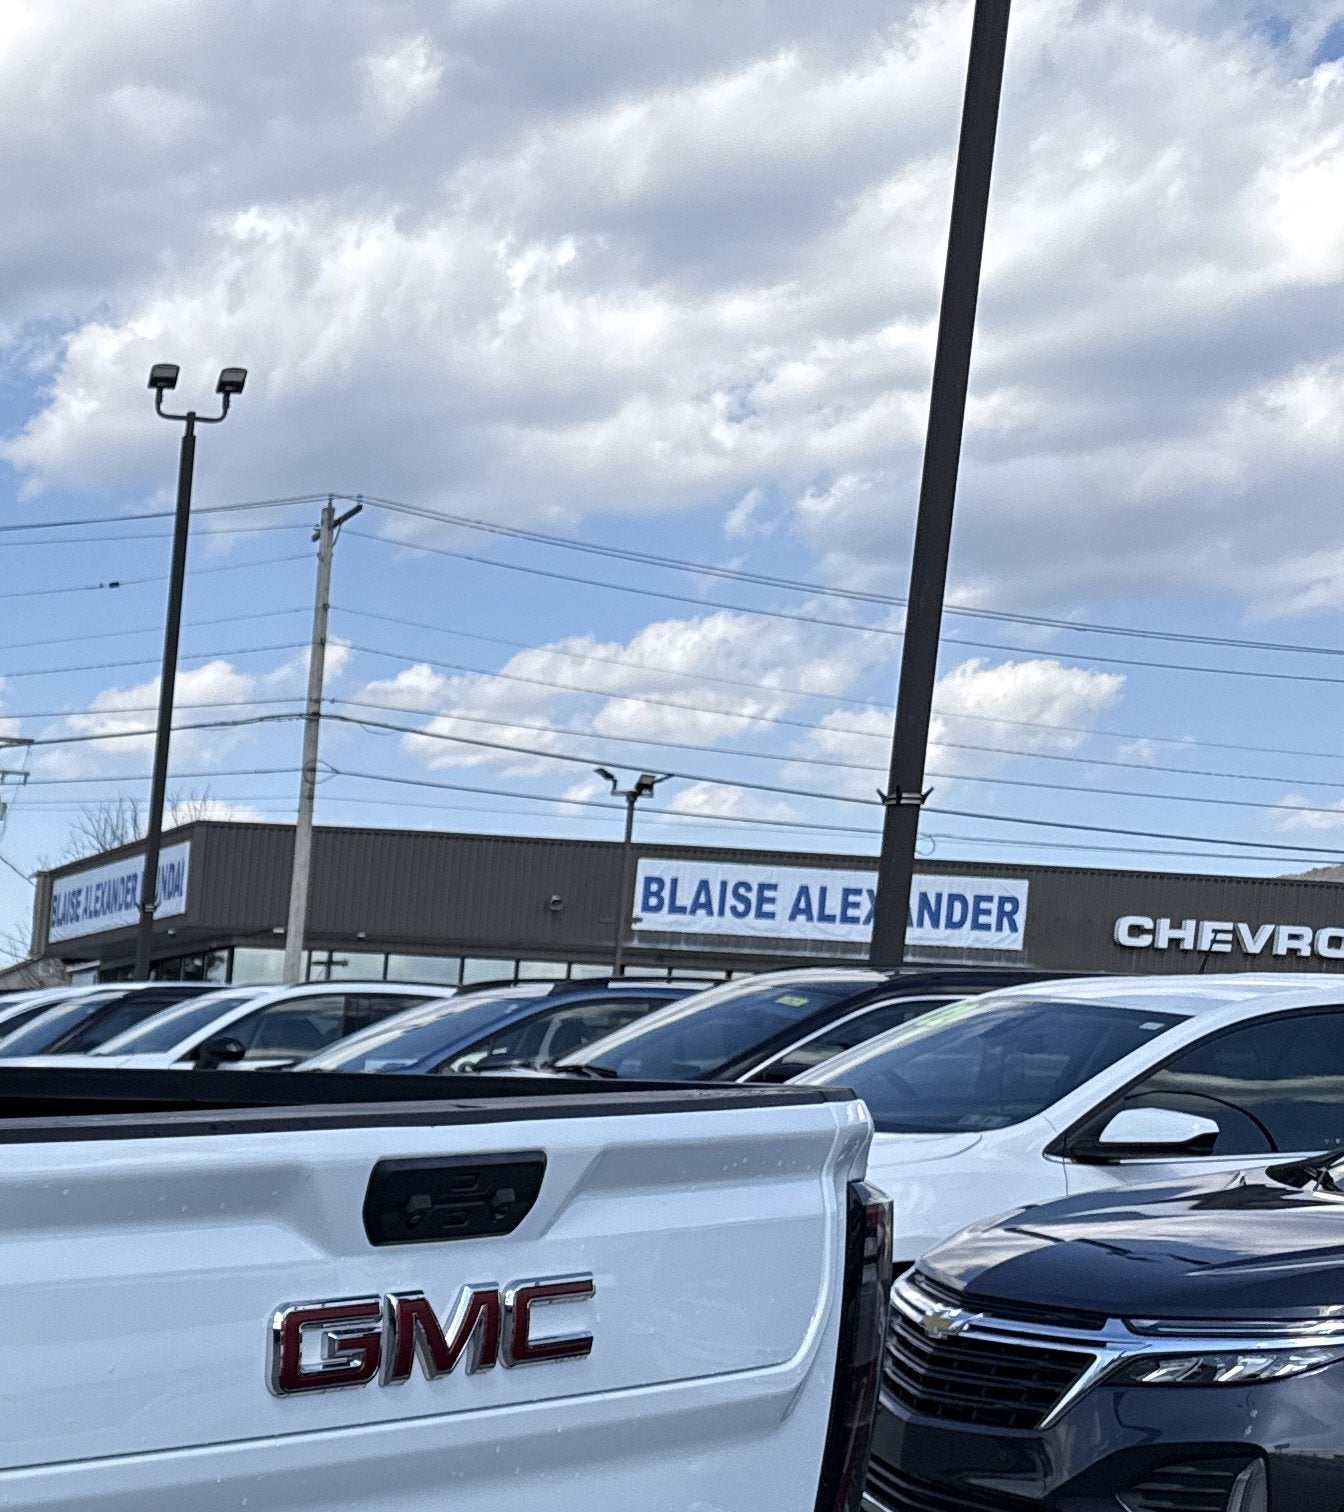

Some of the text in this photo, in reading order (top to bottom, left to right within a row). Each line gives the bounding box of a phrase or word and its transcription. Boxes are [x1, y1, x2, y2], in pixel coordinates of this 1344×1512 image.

[50, 887, 83, 928] BLAISE
[82, 873, 139, 921] ALEXANDER
[640, 876, 1021, 934] BLAISE ALEXNDER
[265, 1271, 597, 1399] GMC
